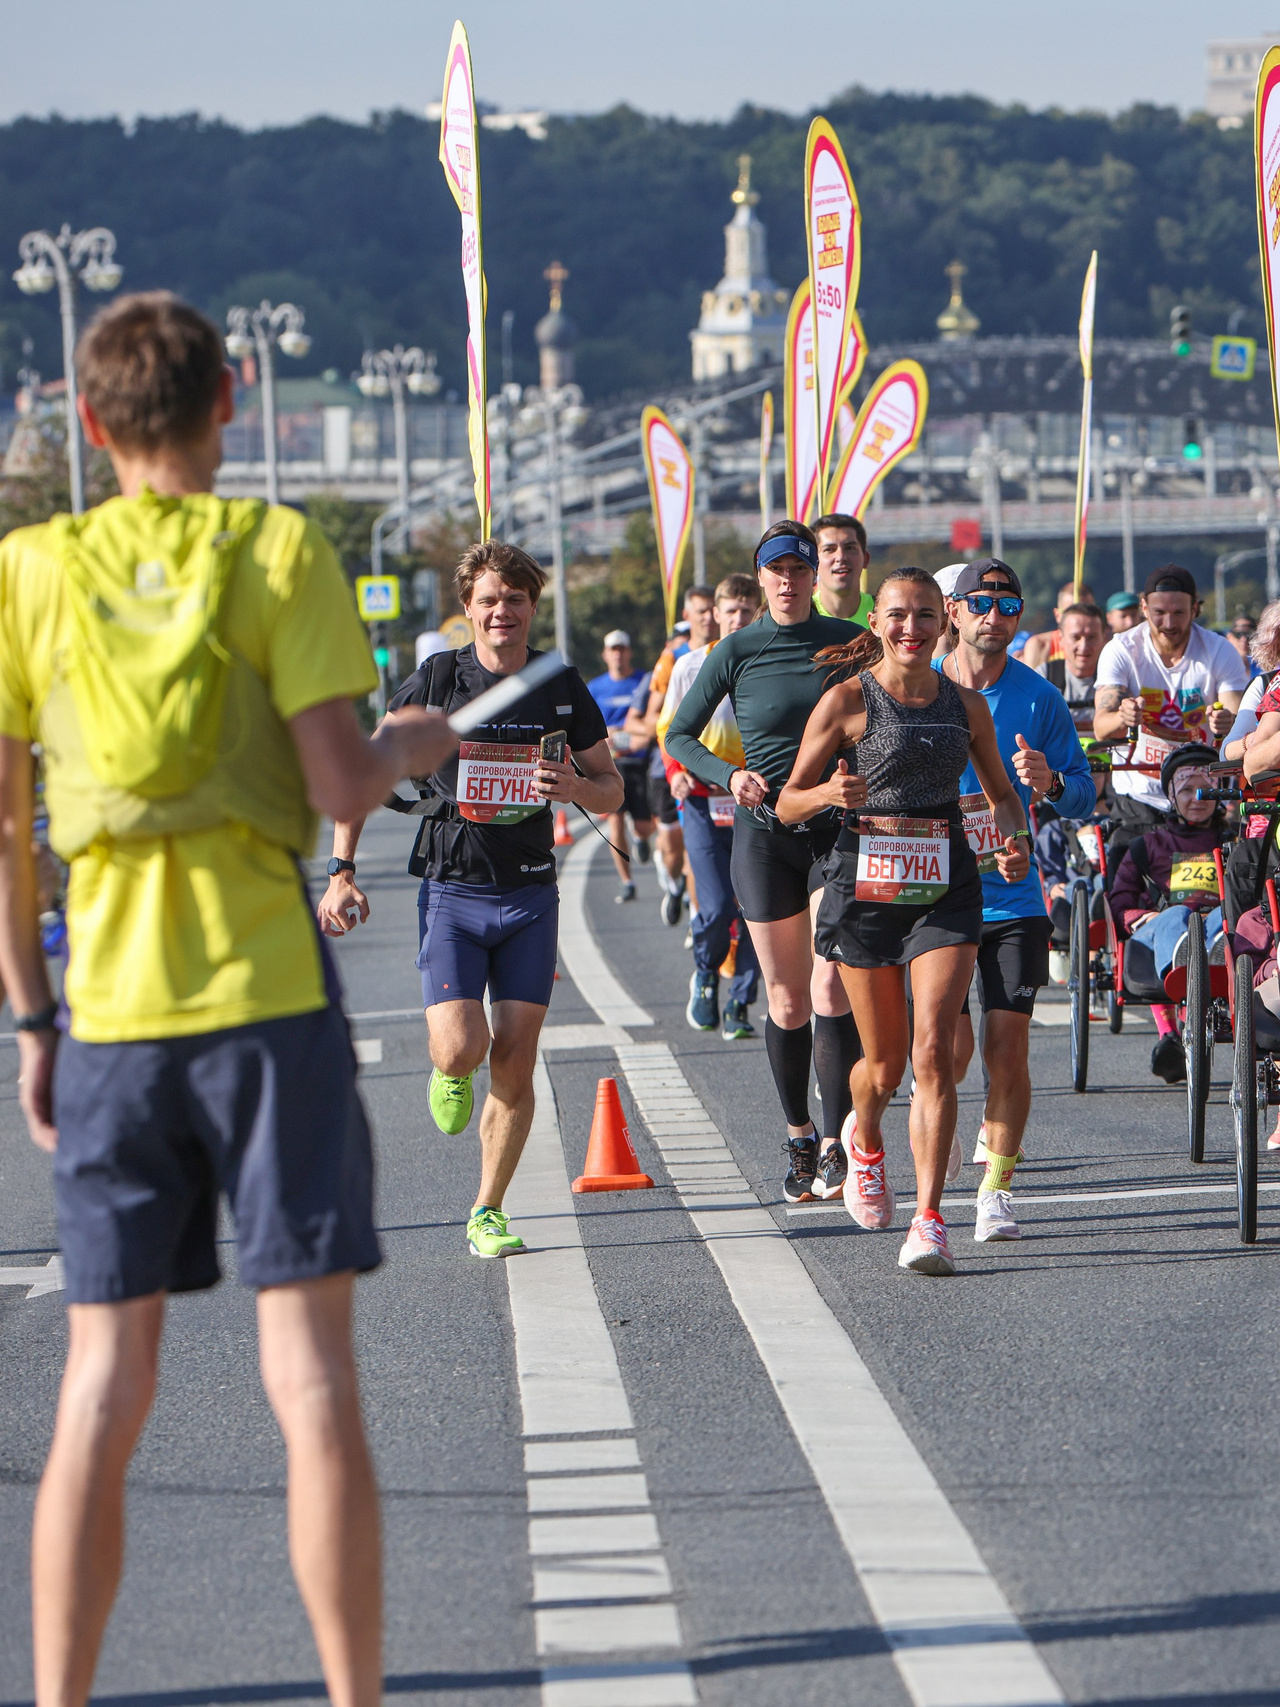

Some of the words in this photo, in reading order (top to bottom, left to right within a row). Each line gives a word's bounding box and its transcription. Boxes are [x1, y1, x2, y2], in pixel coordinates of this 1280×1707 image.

[817, 281, 842, 309] 5:50
[1145, 746, 1169, 762] БЕГ
[468, 765, 538, 777] СОПРОВОЖДЕНИ
[465, 777, 539, 803] БЕГУНА
[868, 841, 941, 854] СОПРОВОЖДЕНИЕ
[866, 853, 942, 881] БЕГУНА
[1177, 891, 1185, 900] G
